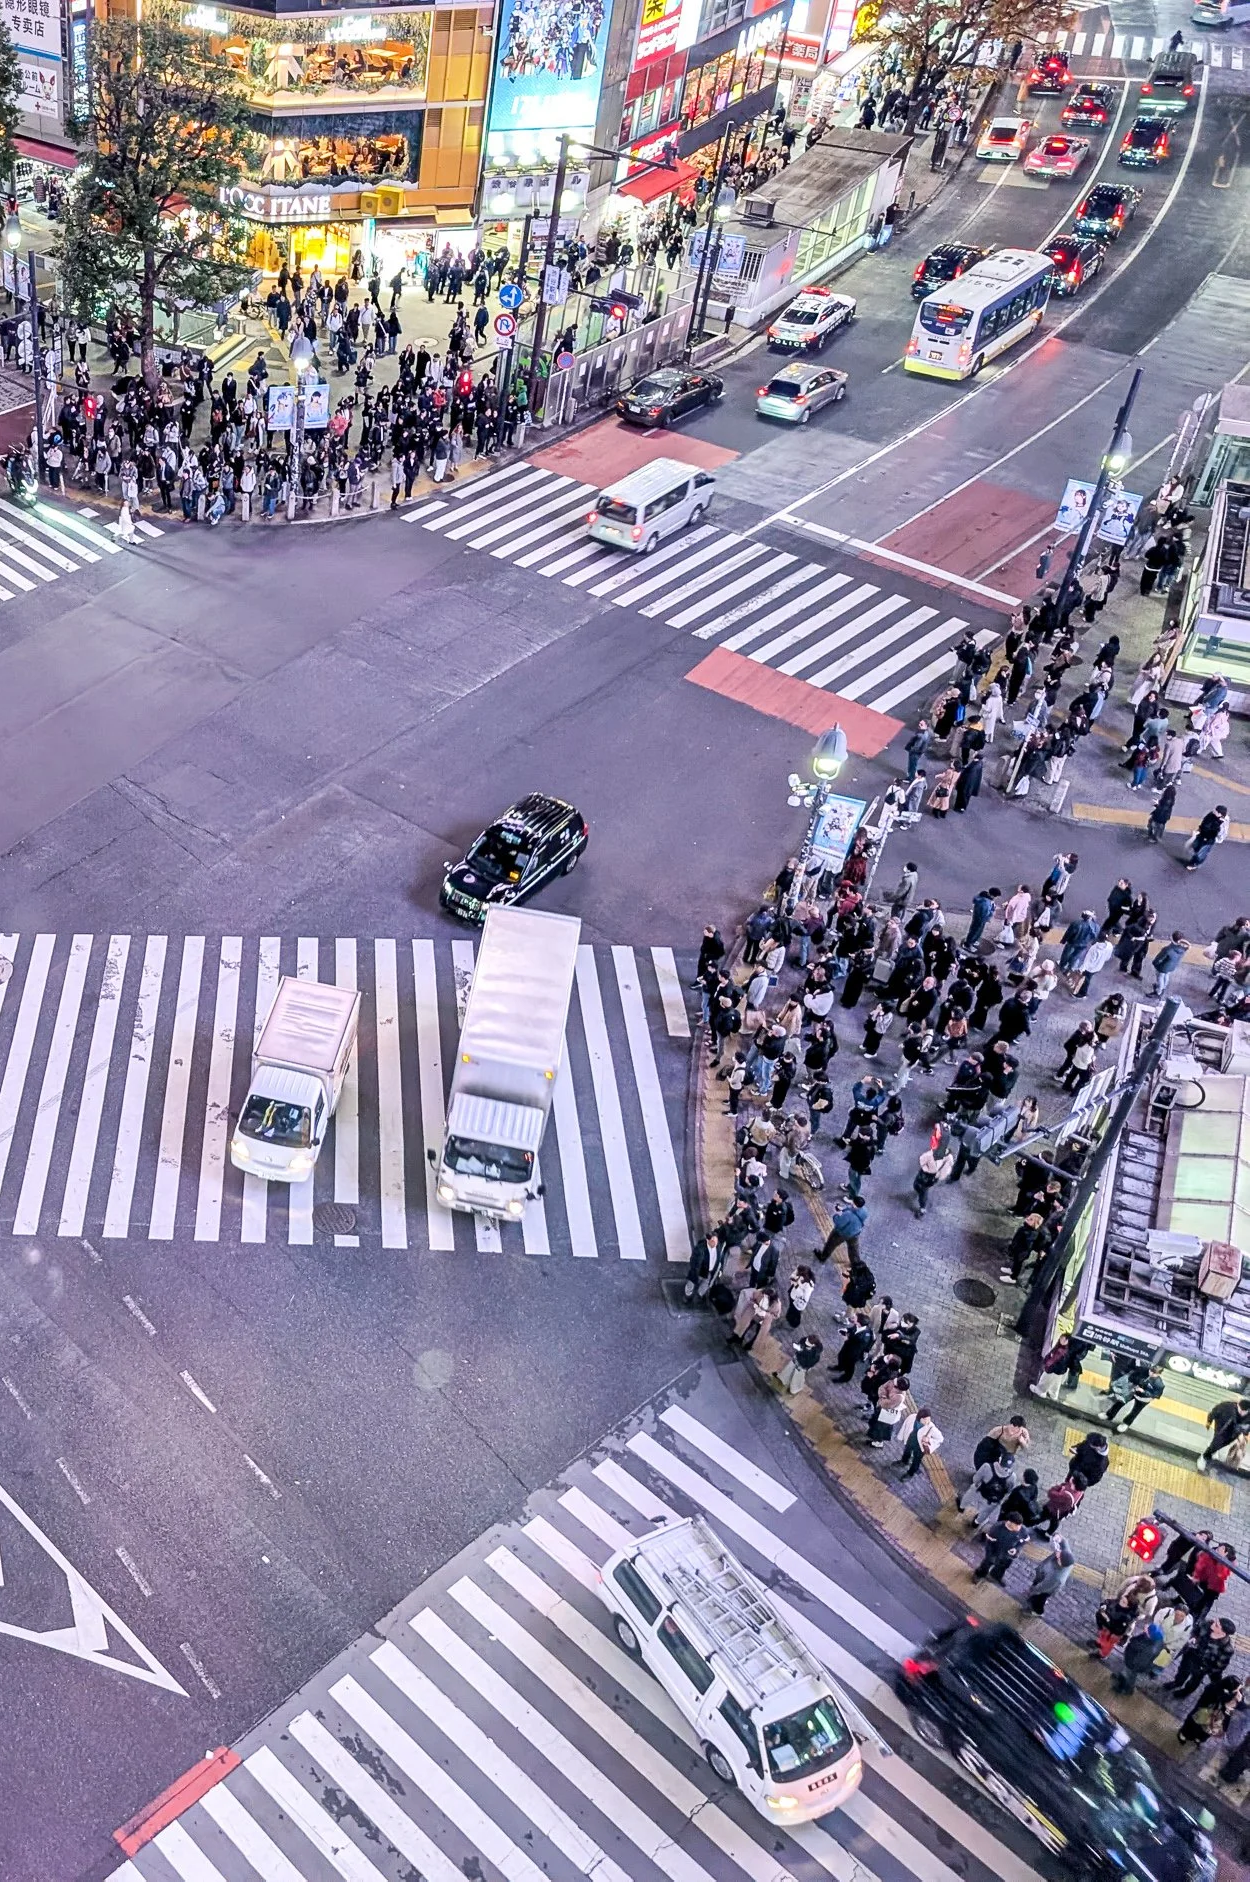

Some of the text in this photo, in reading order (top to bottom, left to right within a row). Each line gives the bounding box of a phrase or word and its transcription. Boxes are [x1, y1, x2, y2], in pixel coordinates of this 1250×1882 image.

[11, 15, 45, 37] 专卖店
[737, 10, 785, 56] LUSH
[769, 336, 808, 348] POLICE
[1093, 1331, 1120, 1348] 渋谷駅
